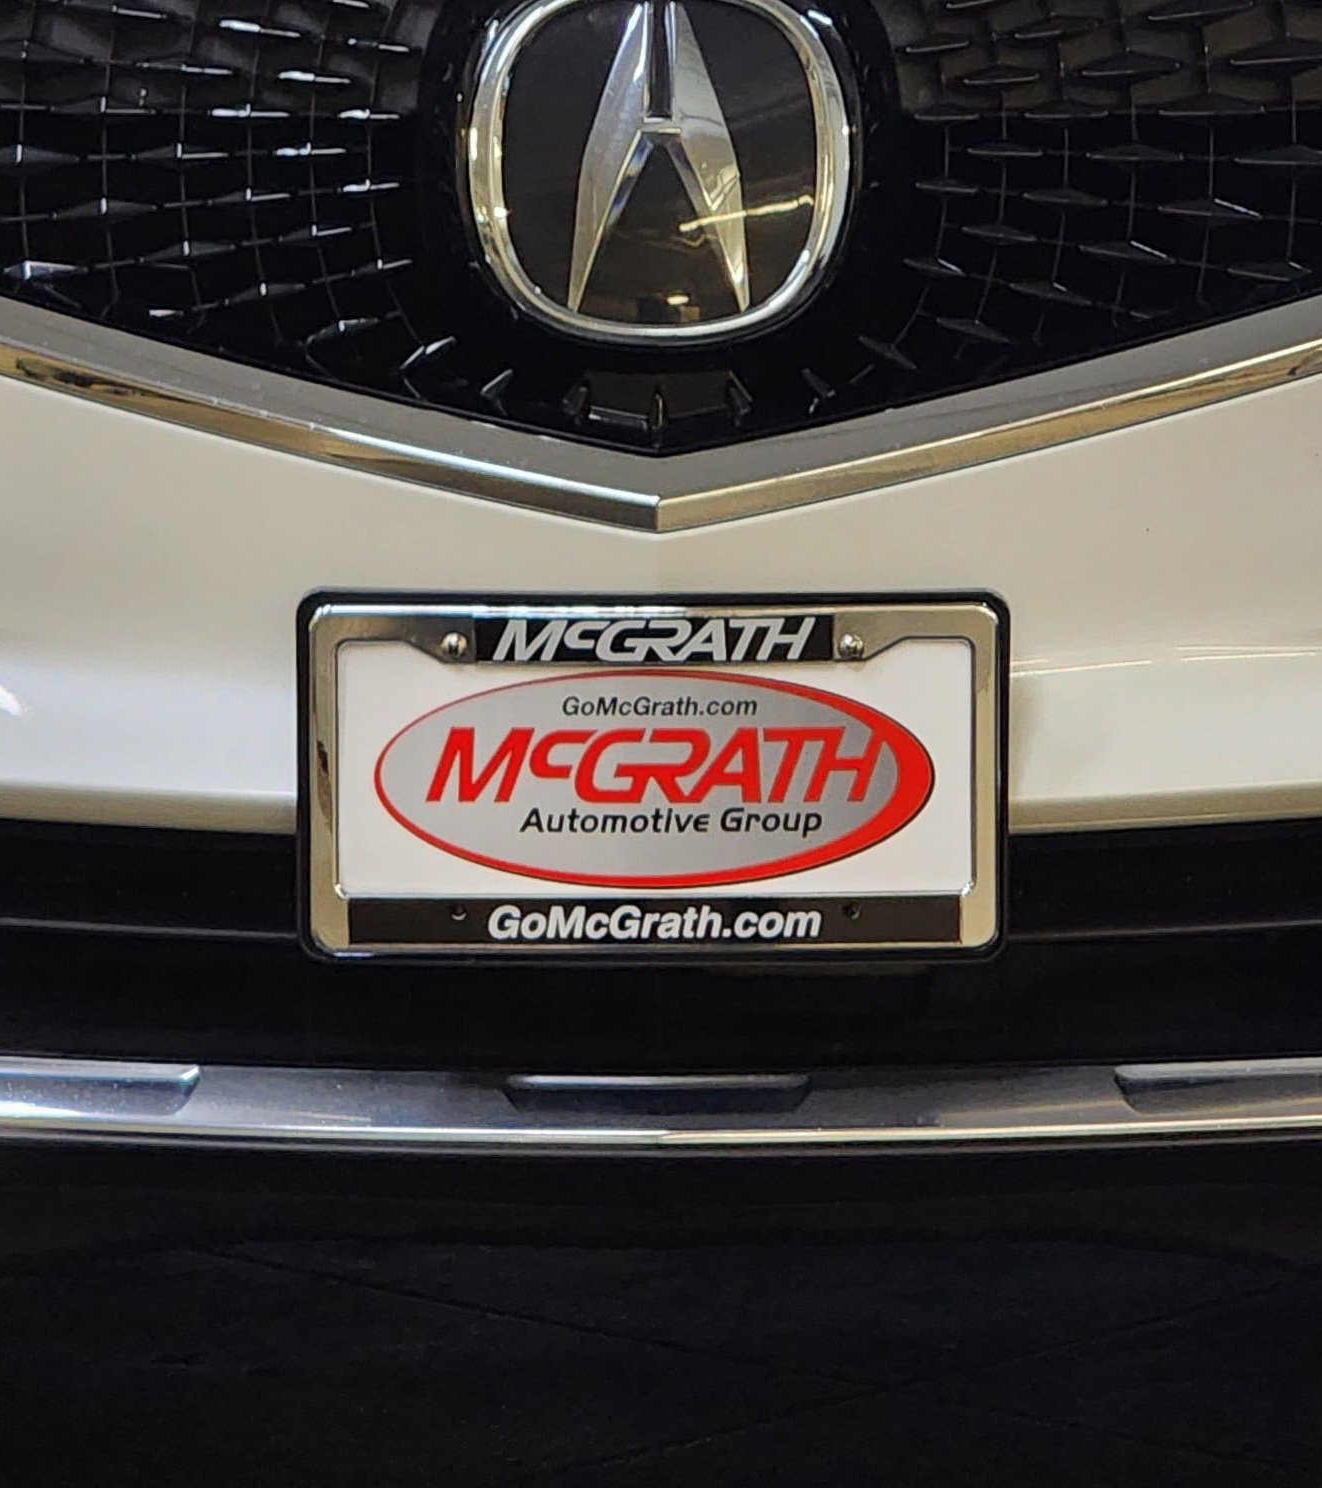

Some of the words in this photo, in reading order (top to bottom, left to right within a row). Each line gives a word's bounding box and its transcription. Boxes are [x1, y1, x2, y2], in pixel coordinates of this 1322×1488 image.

[562, 696, 758, 717] GoMcGrath.com
[519, 807, 710, 834] Automotive
[720, 807, 823, 839] Group
[488, 905, 822, 941] GoMcGrath.com
